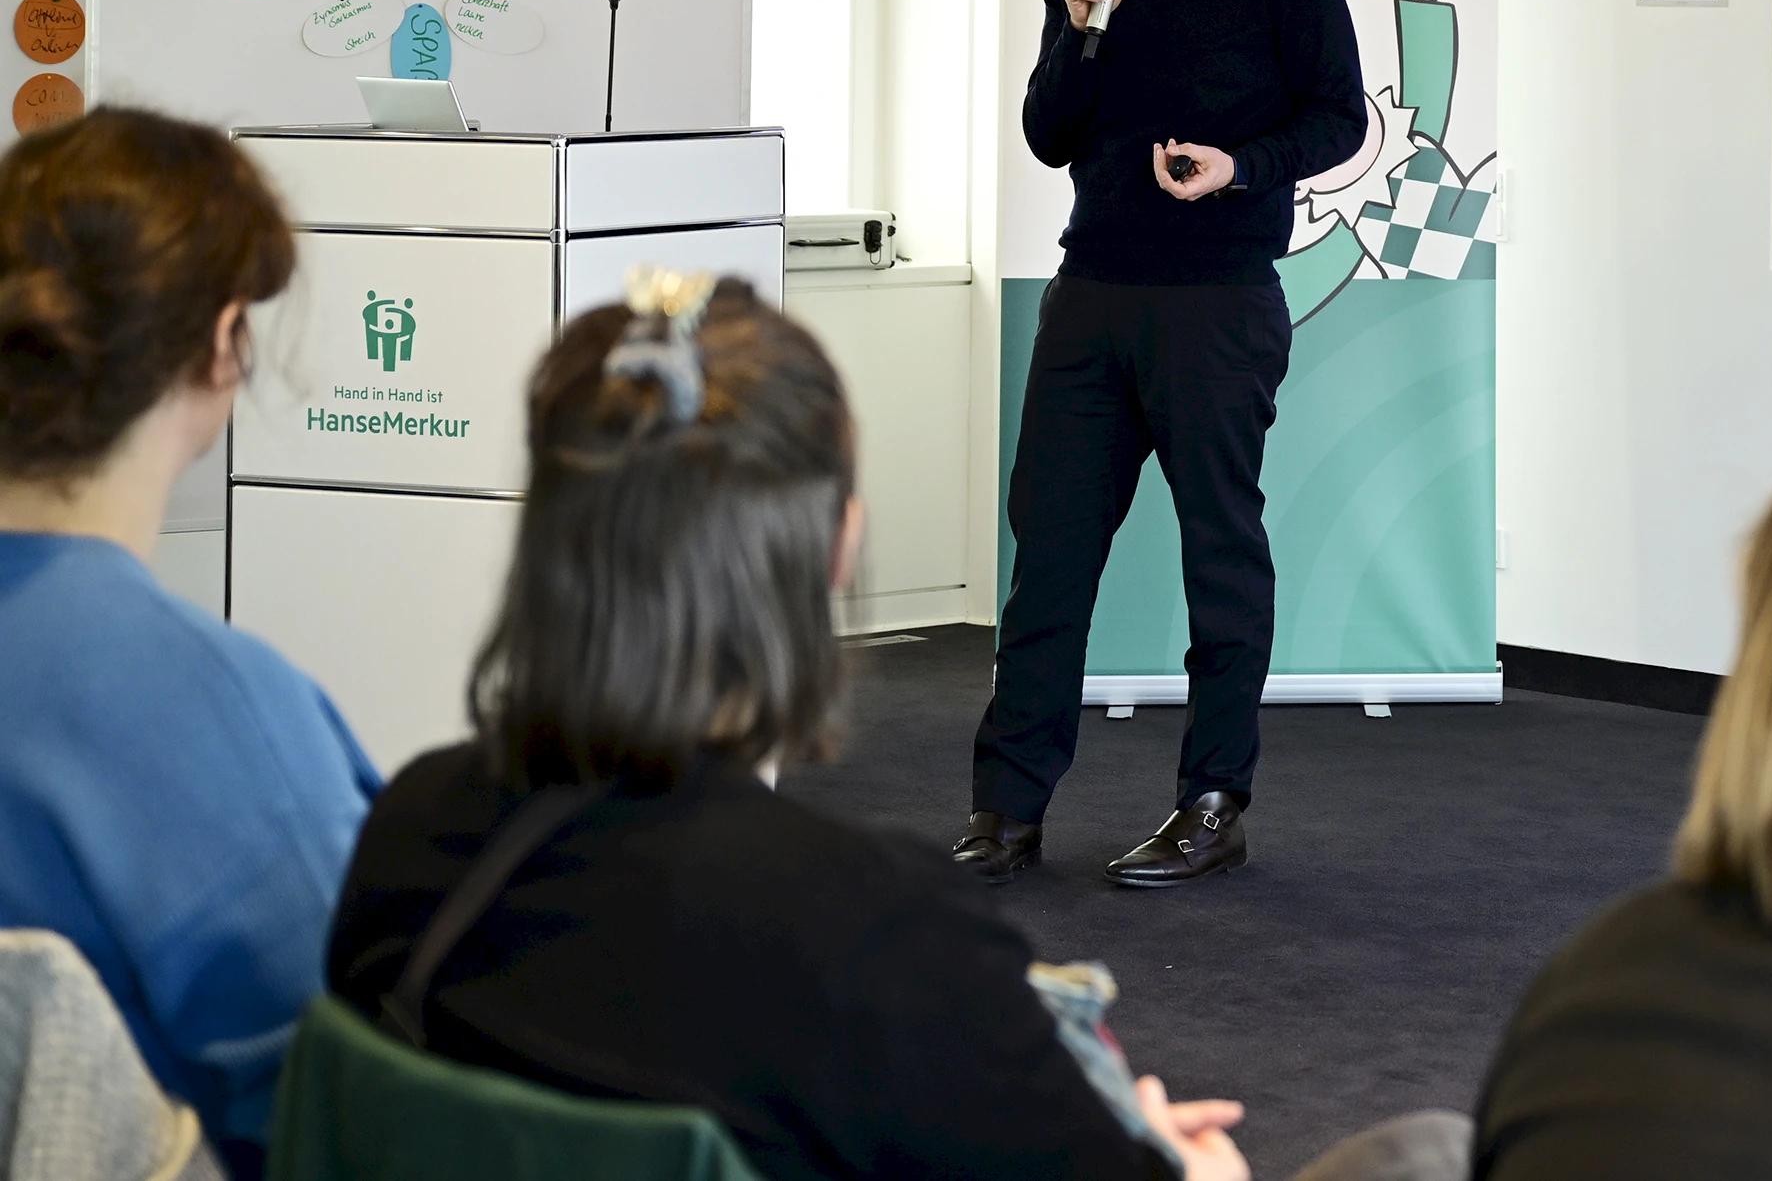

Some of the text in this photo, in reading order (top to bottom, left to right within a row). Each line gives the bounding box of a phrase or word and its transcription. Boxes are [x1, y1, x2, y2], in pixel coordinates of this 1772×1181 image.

[334, 385, 443, 403] Hand in Hand ist
[307, 407, 470, 438] HanseMerkur
